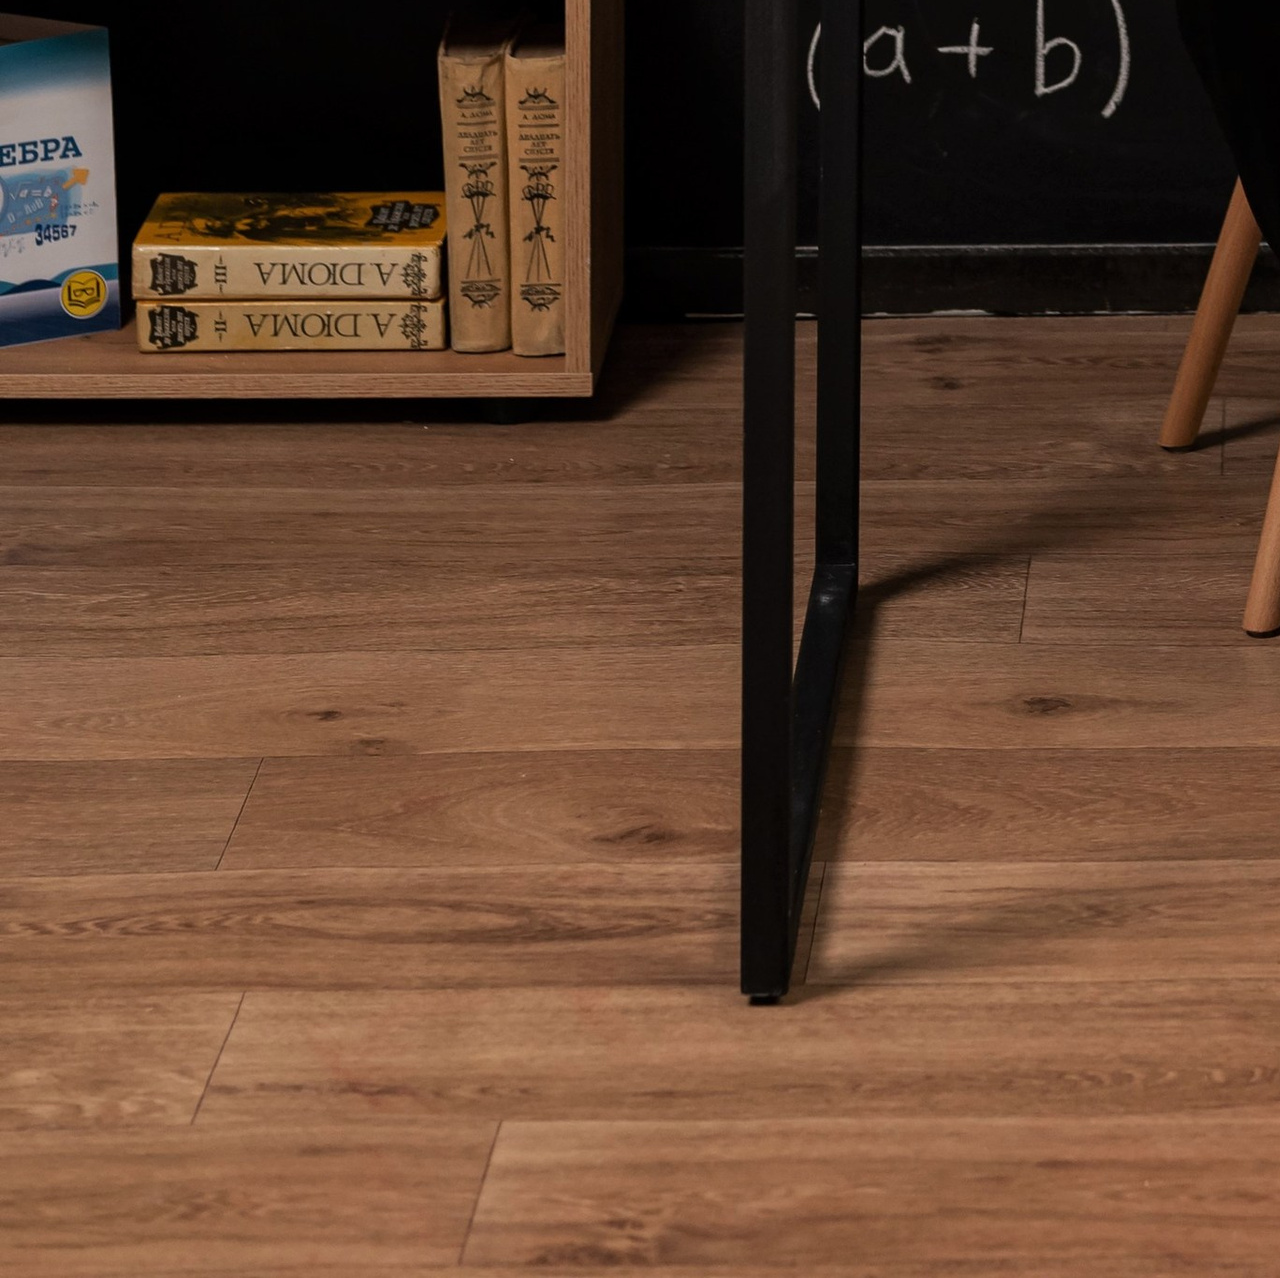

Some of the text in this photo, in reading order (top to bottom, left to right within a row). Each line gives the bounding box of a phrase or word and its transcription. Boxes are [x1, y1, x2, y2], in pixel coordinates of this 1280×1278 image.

[34, 223, 78, 246] 34567
[370, 262, 399, 287] А.
[367, 313, 397, 339] А.
